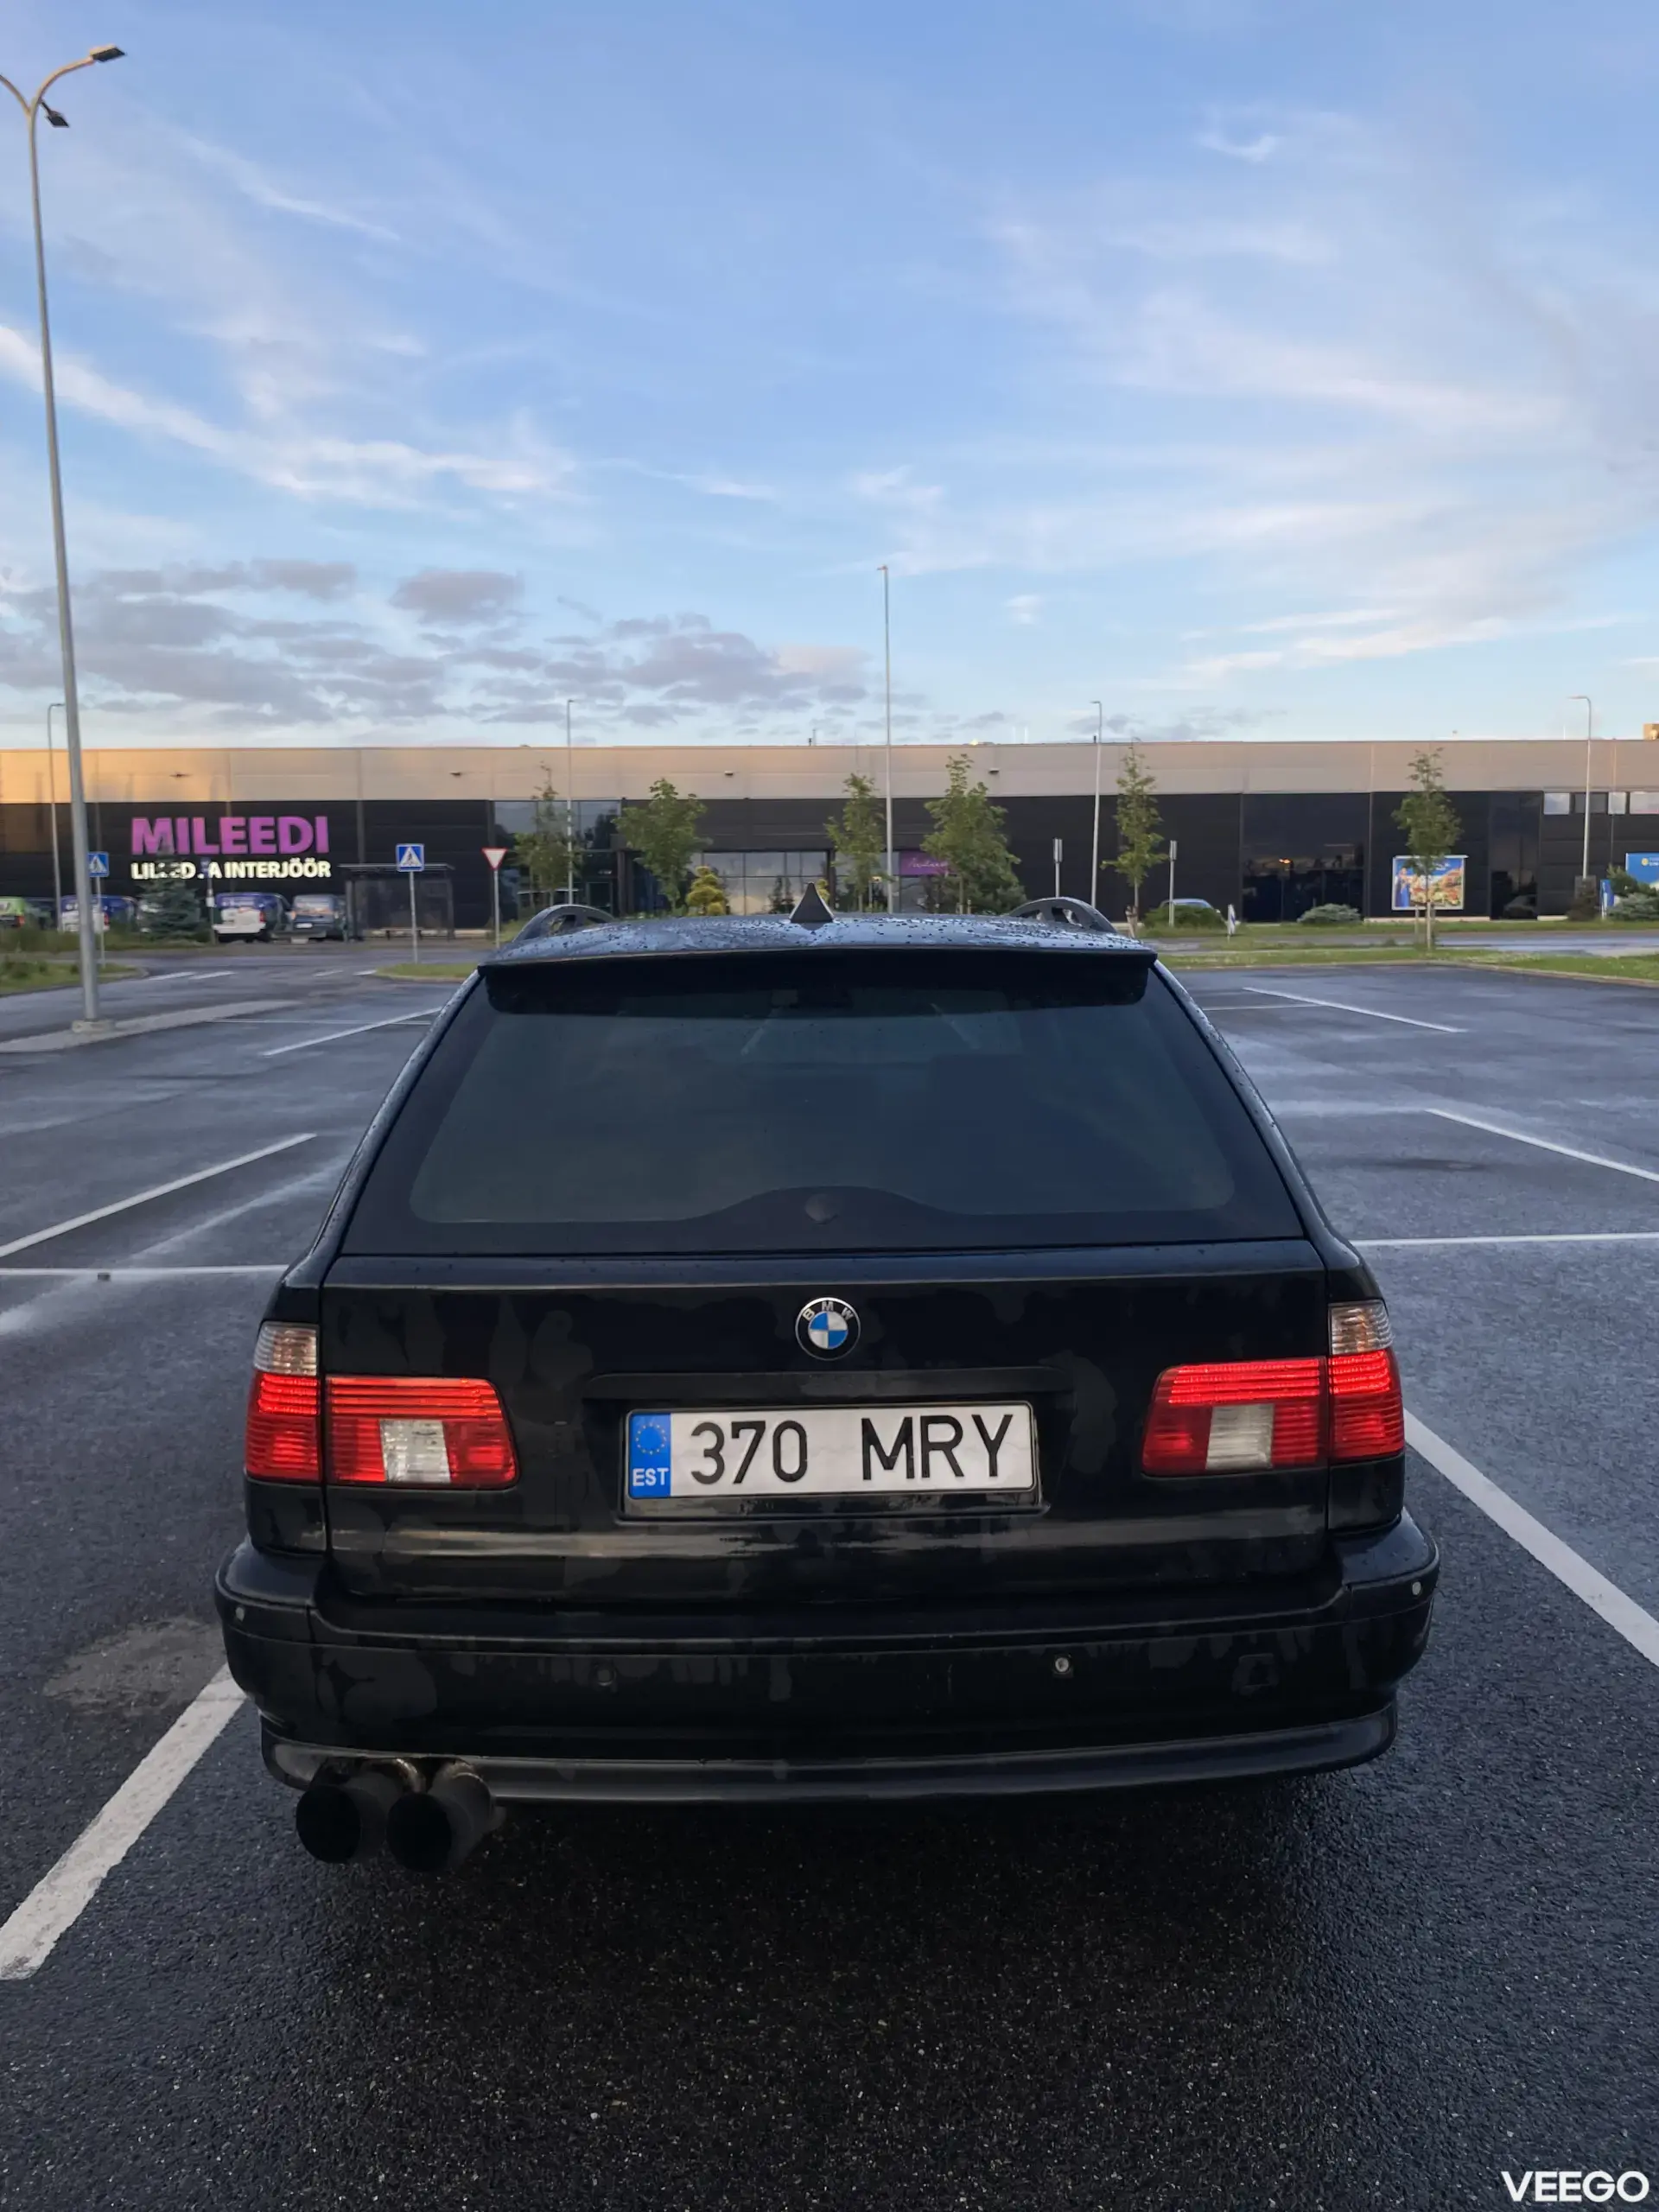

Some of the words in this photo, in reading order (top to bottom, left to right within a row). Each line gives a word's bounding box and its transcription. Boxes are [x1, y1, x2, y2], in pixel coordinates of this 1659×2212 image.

[131, 816, 330, 855] MILEEDI
[197, 861, 222, 880] A
[802, 1300, 855, 1322] BMW
[690, 1420, 808, 1484] 370
[861, 1414, 1014, 1481] MRY
[632, 1467, 670, 1486] EST
